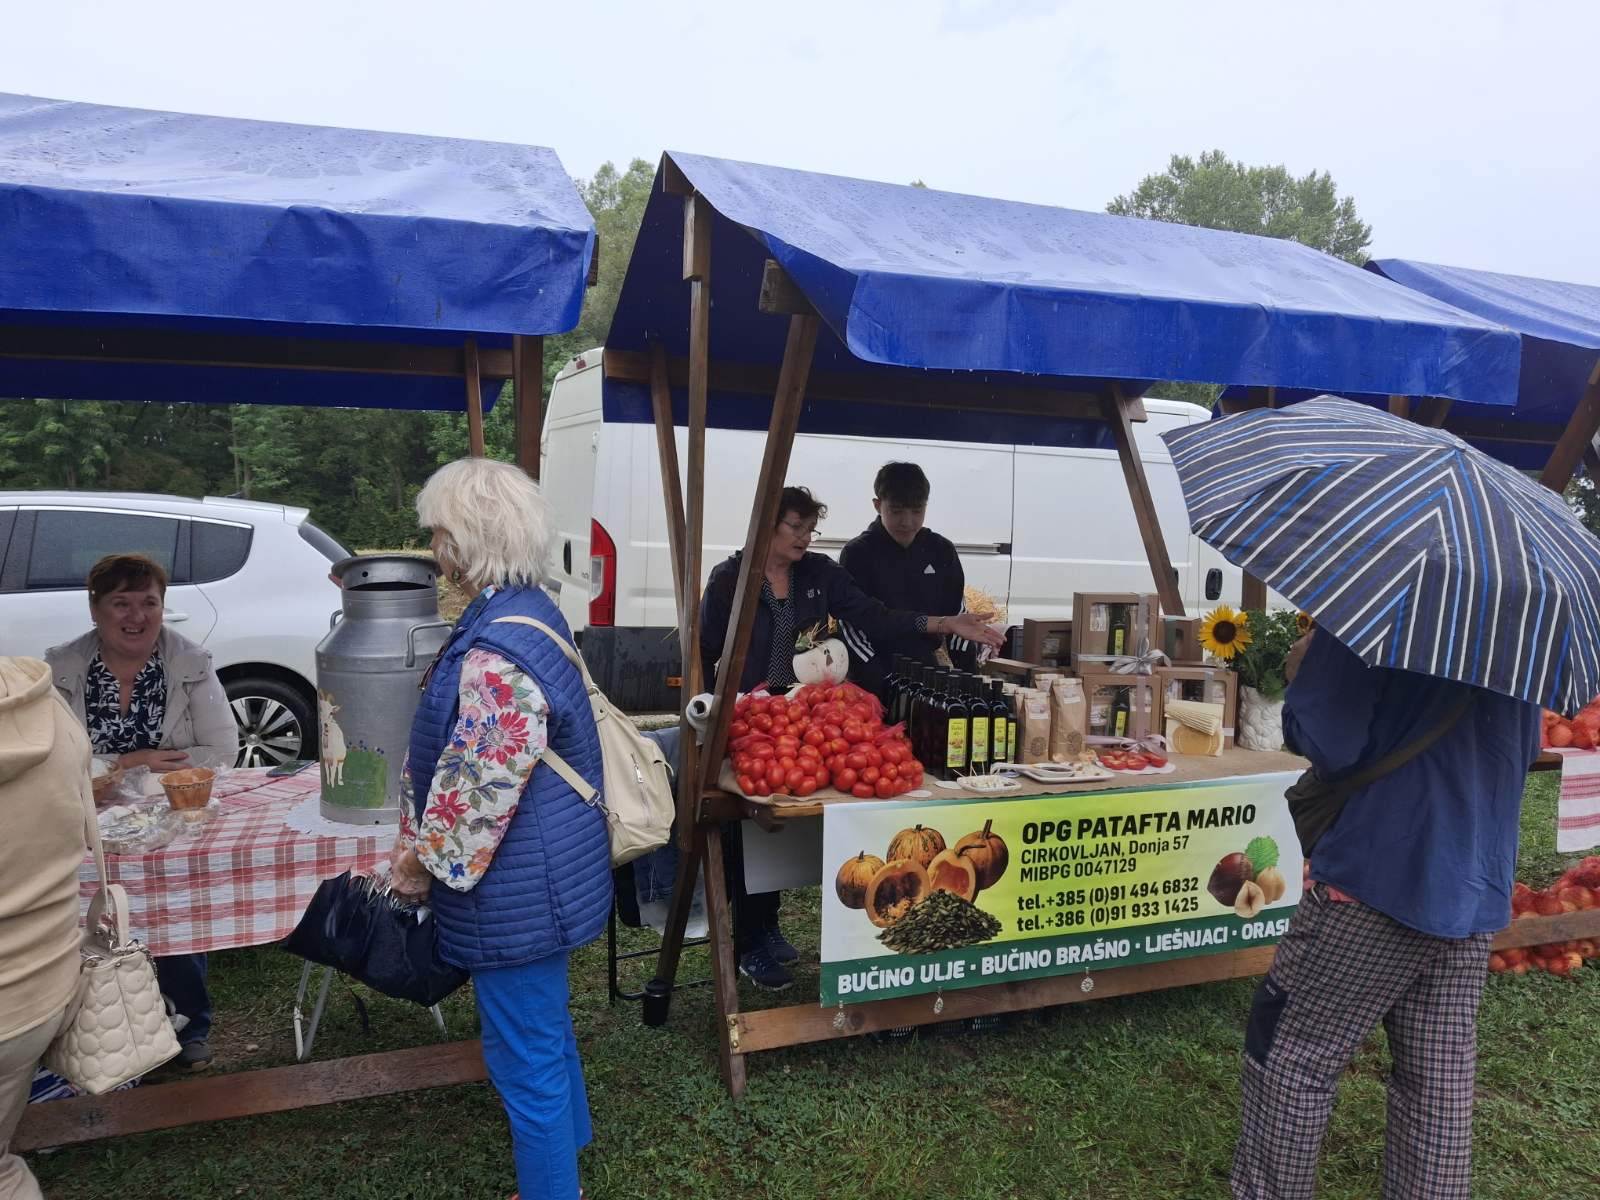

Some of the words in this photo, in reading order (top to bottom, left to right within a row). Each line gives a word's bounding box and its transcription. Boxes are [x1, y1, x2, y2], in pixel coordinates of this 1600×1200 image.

[1022, 820, 1072, 844] OPG
[1077, 811, 1180, 839] PATAFTA
[1186, 804, 1256, 830] MARIO
[1021, 841, 1125, 865] CIRKOVLJAN,
[1128, 837, 1169, 857] Donja
[1173, 835, 1190, 851] 57
[1020, 864, 1070, 883] MIBPG
[1074, 857, 1137, 877] 0047129
[1089, 884, 1126, 907] (0)91
[1130, 881, 1159, 900] 494
[1162, 876, 1199, 896] 6832
[1090, 905, 1126, 927] (0)91
[1131, 901, 1160, 920] 933
[1164, 896, 1199, 915] 1425
[838, 966, 914, 994] BUČINO
[920, 960, 965, 983] ULJE
[981, 948, 1051, 975] BUČINO
[1056, 938, 1130, 965] BRAŠNO
[1145, 927, 1228, 954] LJEŠNJACI
[1241, 918, 1289, 940] ORASI
